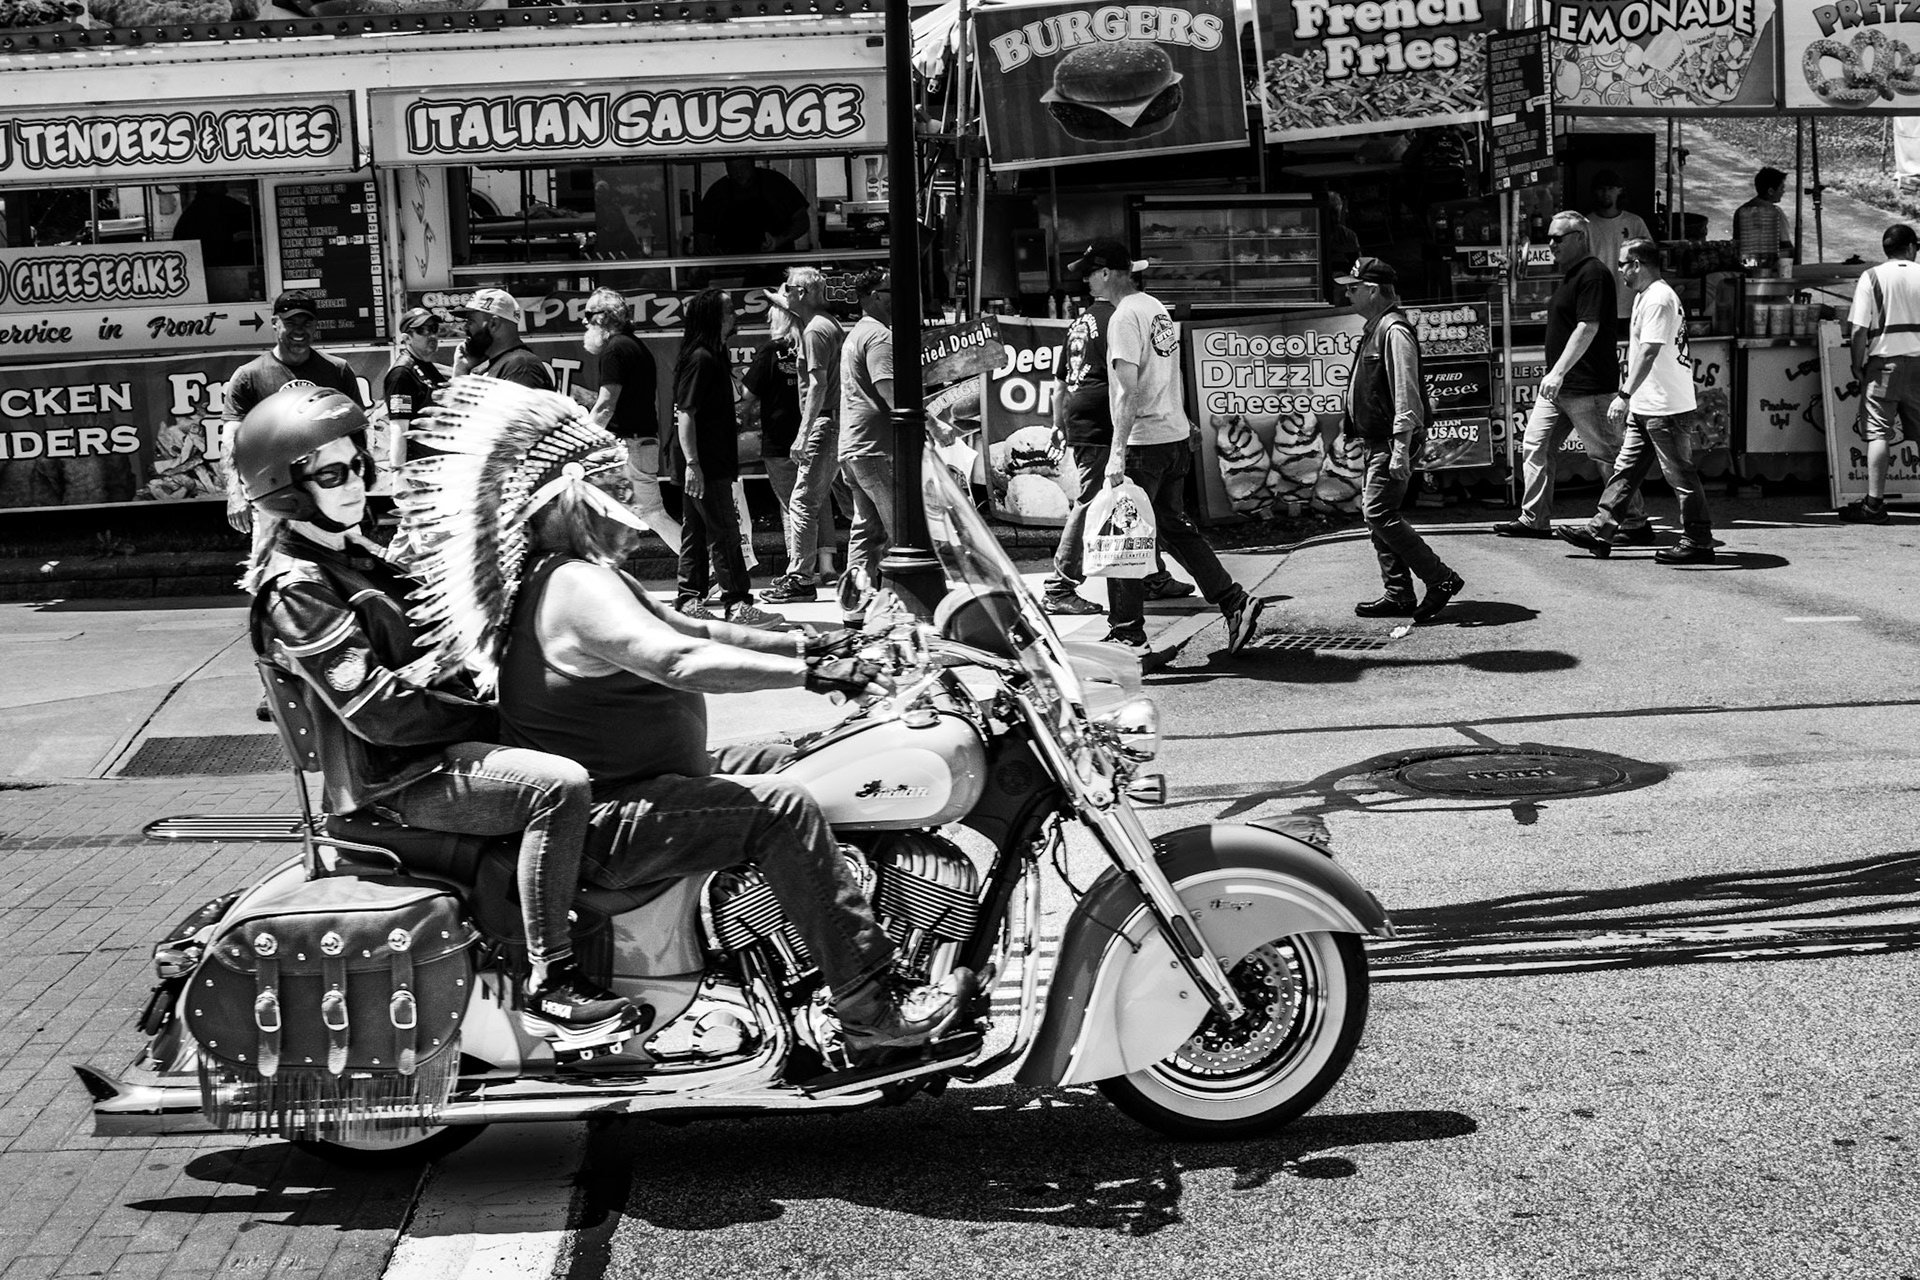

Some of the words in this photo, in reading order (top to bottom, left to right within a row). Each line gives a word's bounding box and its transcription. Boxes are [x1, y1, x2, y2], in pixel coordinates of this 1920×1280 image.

[1292, 0, 1482, 38] French
[989, 5, 1223, 73] BURGERS
[1323, 33, 1458, 77] Fries
[408, 98, 606, 152] ITALIAN
[612, 86, 861, 142] SAUSAGE
[16, 113, 196, 169] TENDERS
[199, 116, 221, 159] &
[222, 108, 337, 156] FRIES
[12, 253, 187, 302] CHEESECAKE
[421, 291, 476, 309] Chee
[98, 317, 123, 341] in
[147, 311, 228, 340] Front
[1406, 306, 1477, 326] French
[949, 322, 992, 354] Dough
[1417, 322, 1469, 341] Fries
[1202, 359, 1349, 389] Drizzle
[1435, 372, 1463, 382] FRIED
[1, 382, 133, 417] CKEN
[1207, 391, 1347, 415] Cheeseca
[1426, 425, 1479, 442] USAGE
[1114, 537, 1154, 552] TIGERS
